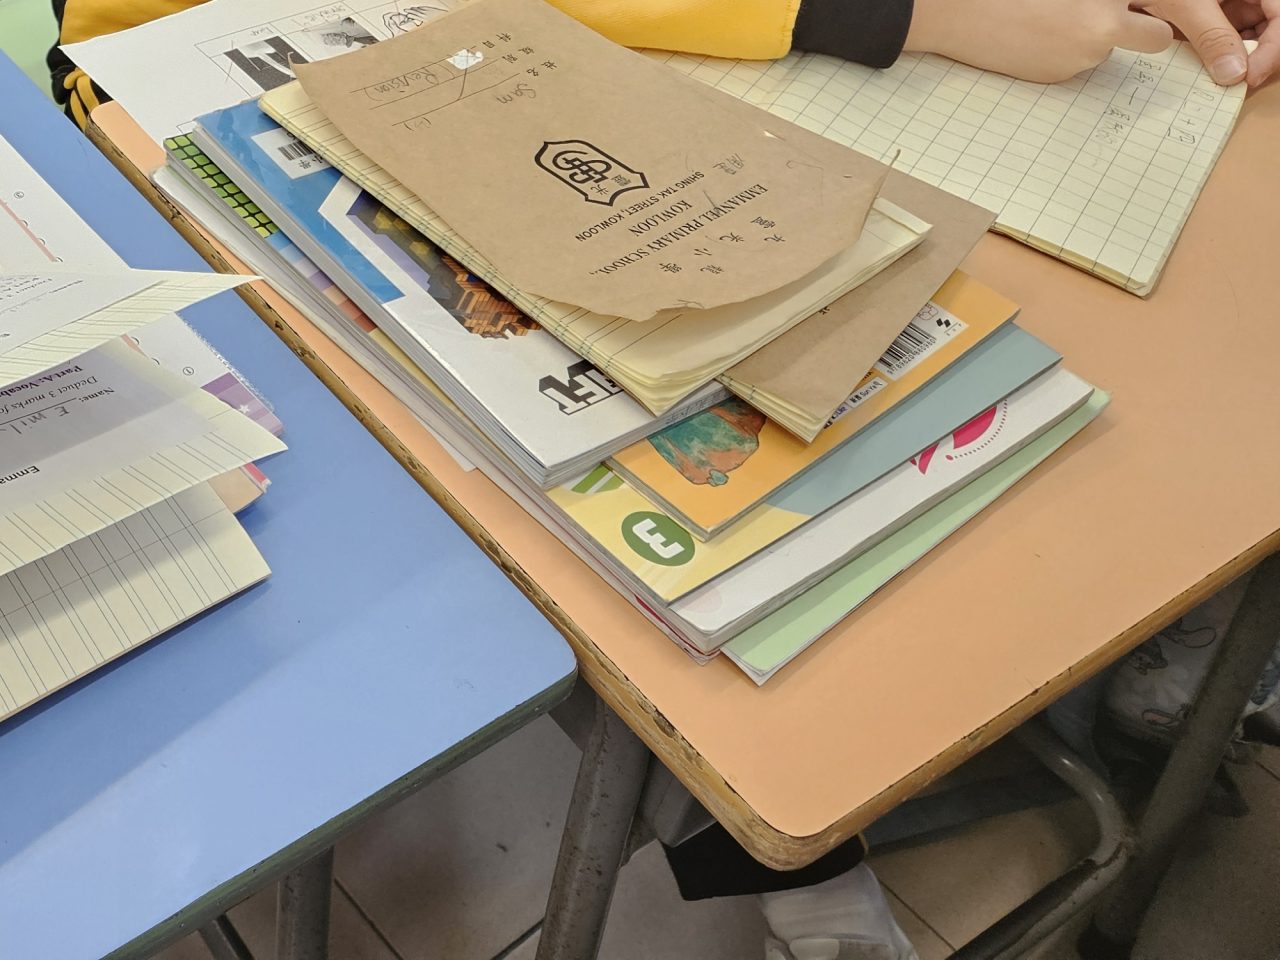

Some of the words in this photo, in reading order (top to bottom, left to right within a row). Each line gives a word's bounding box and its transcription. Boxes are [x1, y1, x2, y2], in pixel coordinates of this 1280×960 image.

[493, 82, 537, 104] Sam
[673, 170, 705, 189] SHING
[655, 185, 678, 199] TAK
[619, 195, 659, 216] STREET,
[697, 183, 768, 227] EMMANUEL
[573, 212, 624, 242] KOWLOON
[627, 198, 693, 237] KOWLOON
[645, 217, 703, 251] PRIMARY
[36, 372, 56, 383] A:
[55, 364, 83, 378] Part
[56, 374, 98, 394] Deduct
[9, 393, 46, 409] marks
[77, 386, 115, 403] Name:
[631, 517, 685, 559] 3
